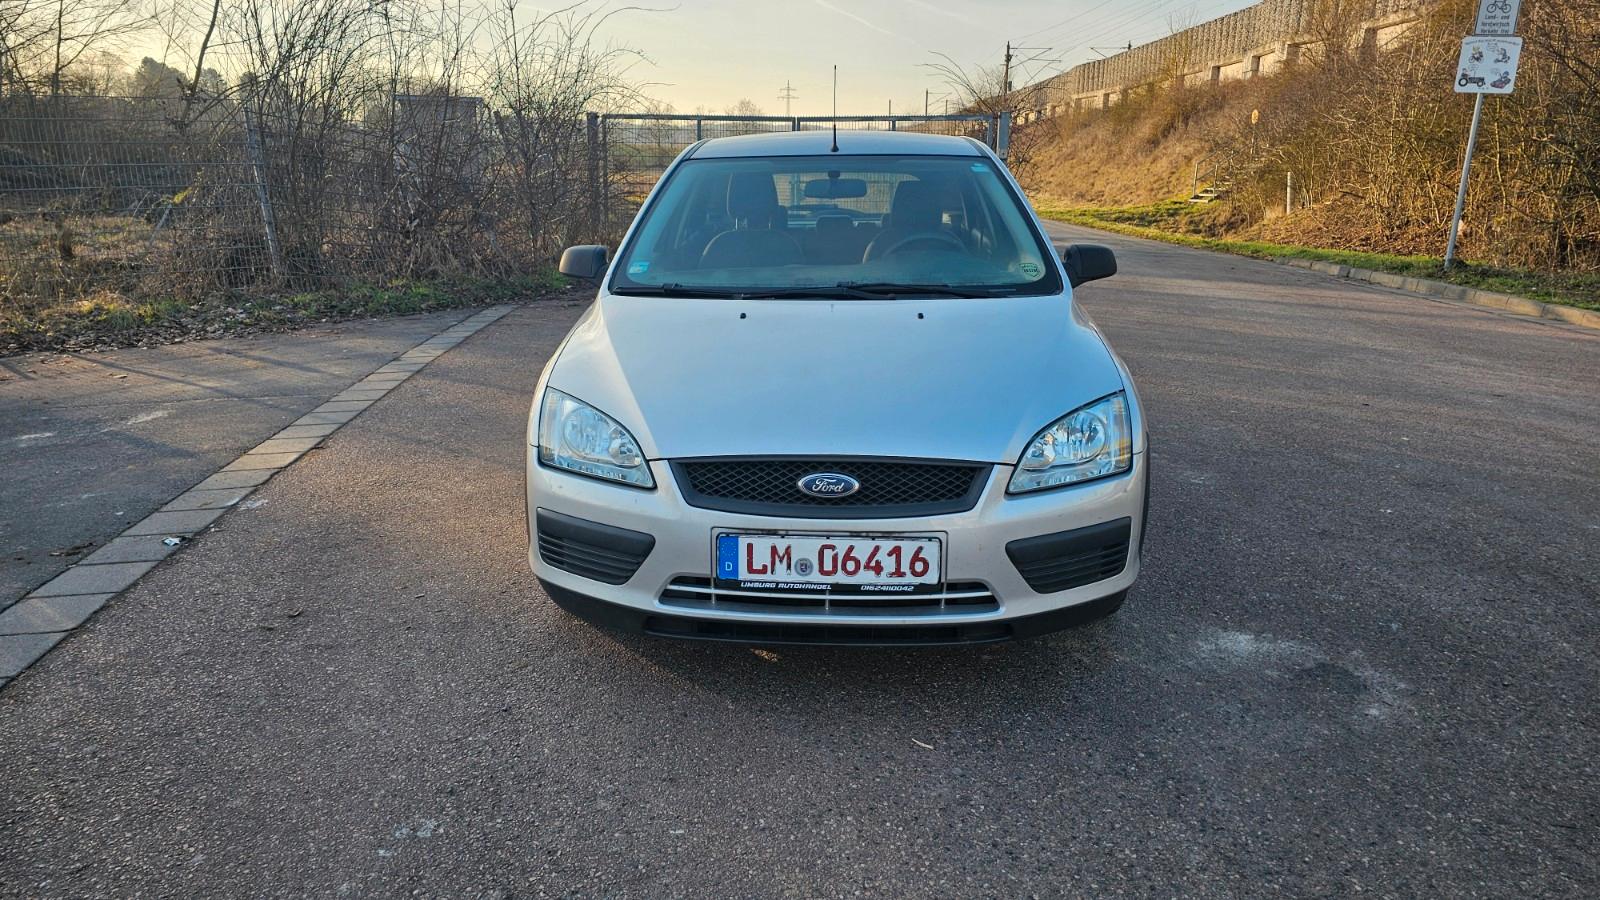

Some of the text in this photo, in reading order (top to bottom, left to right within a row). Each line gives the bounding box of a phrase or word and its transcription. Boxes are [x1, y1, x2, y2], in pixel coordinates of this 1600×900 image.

[812, 478, 845, 492] Ford
[725, 543, 930, 577] D LM 06416
